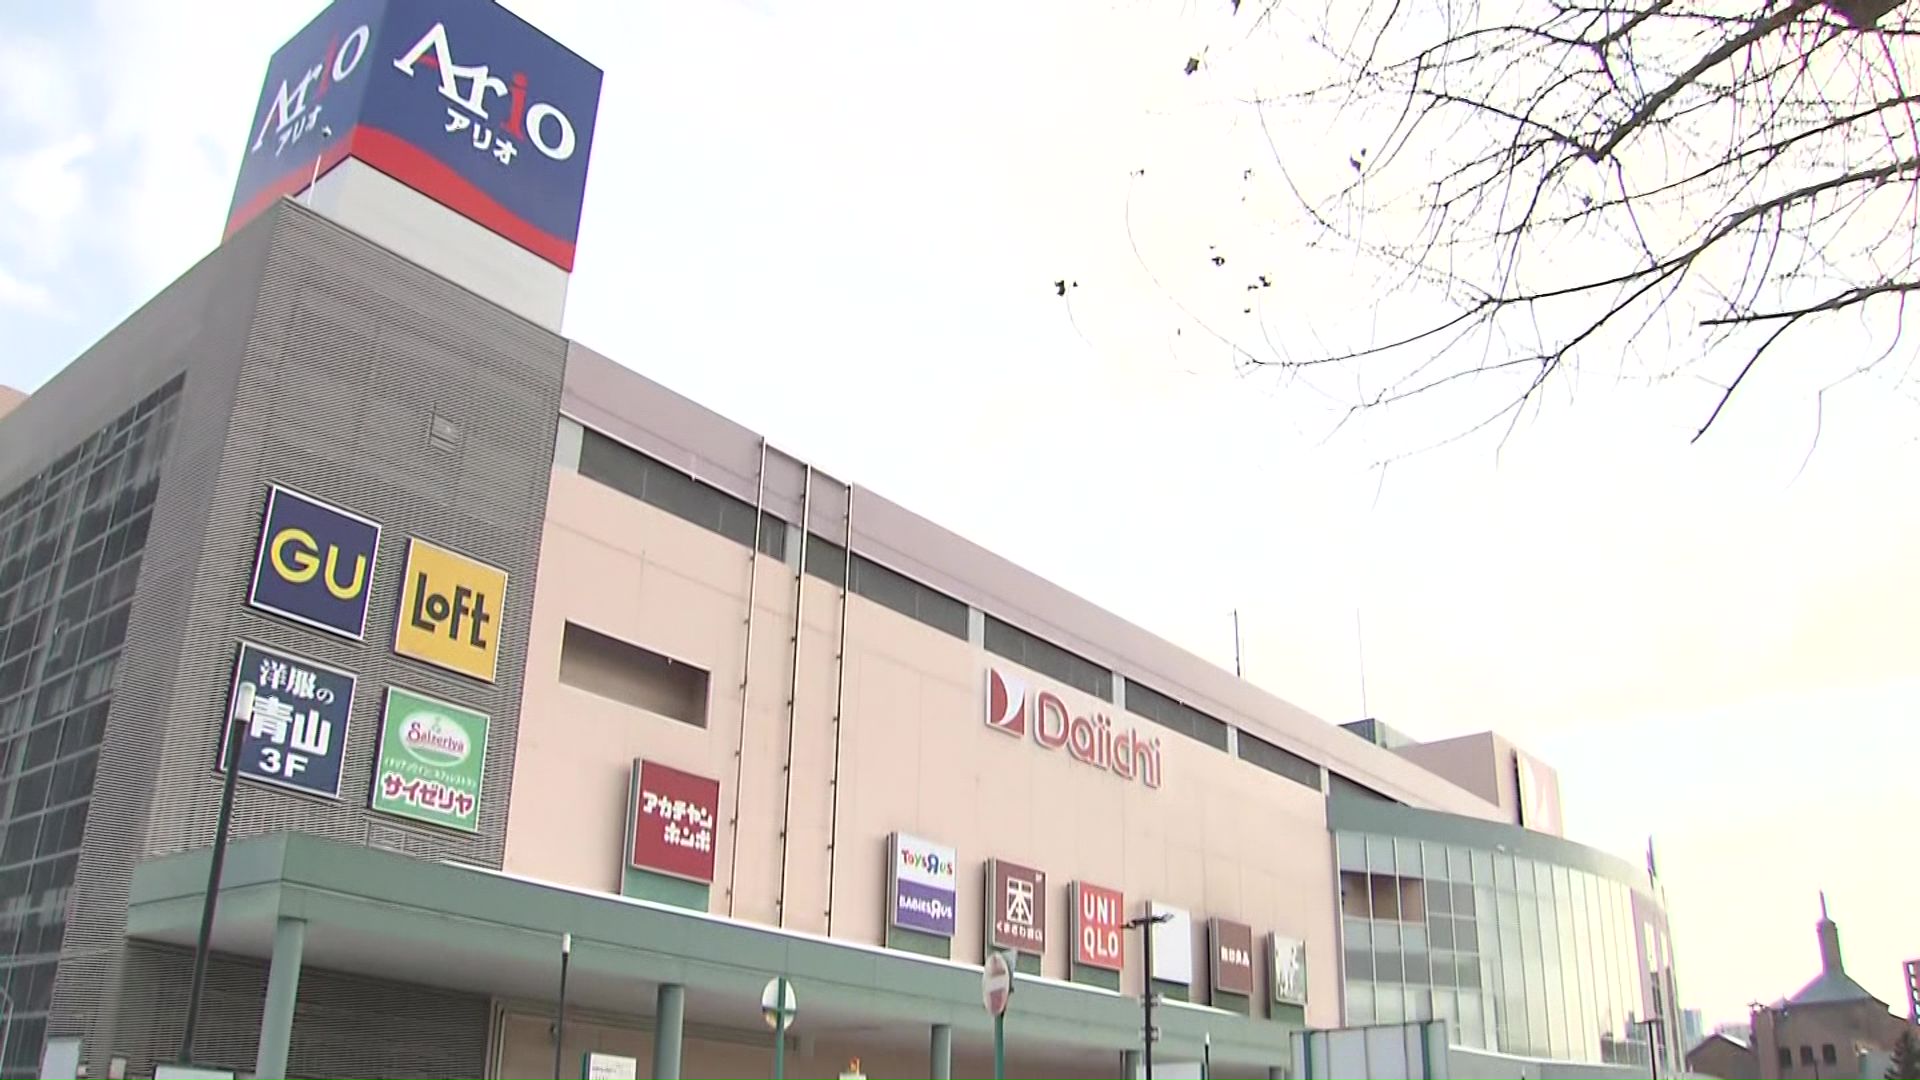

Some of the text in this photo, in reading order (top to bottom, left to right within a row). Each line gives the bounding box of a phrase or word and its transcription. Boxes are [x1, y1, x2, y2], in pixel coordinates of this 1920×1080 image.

[251, 24, 370, 152] Ario
[393, 22, 576, 161] Ario
[445, 108, 518, 165] アリオ
[269, 527, 367, 600] GU
[258, 659, 335, 705] 洋服の
[250, 693, 332, 756] 青山
[407, 721, 465, 754] Saizeriya
[1034, 691, 1162, 787] Daiichi
[258, 747, 309, 779] 3F
[382, 772, 474, 816] サイゼリヤ
[642, 789, 713, 830] アカチャン
[1083, 891, 1116, 926] UNI
[1083, 926, 1119, 960] QLO
